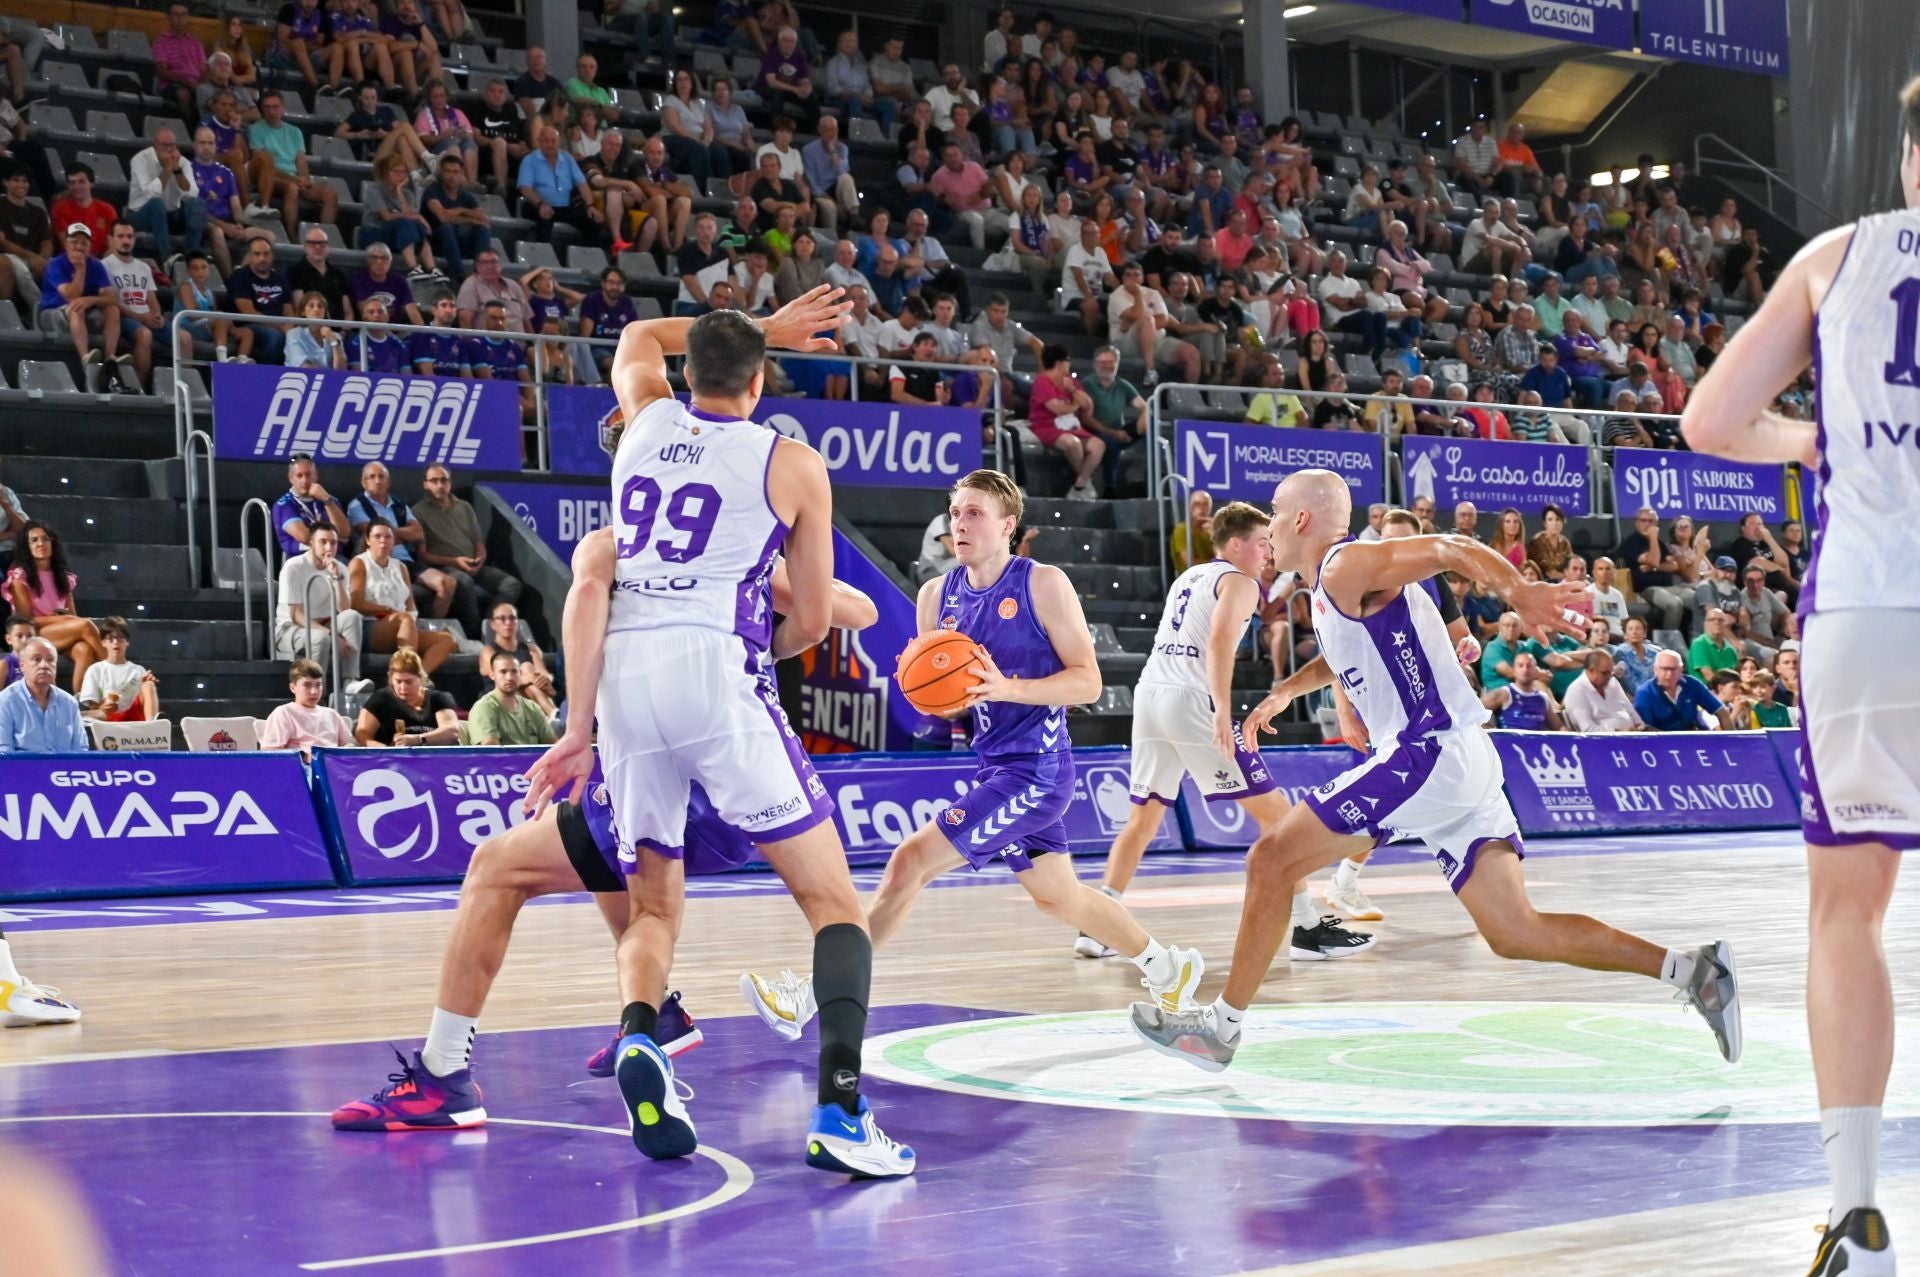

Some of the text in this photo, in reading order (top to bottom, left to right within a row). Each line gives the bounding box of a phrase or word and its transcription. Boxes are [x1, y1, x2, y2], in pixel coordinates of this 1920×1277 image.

[1532, 5, 1590, 28] OCASIÓN
[1651, 33, 1780, 69] TALENTTIUM
[113, 274, 148, 290] OSLO
[253, 371, 484, 465] ALCOPAL
[820, 410, 962, 475] ovlac
[1864, 421, 1920, 449] IV
[1234, 445, 1373, 470] MORALESCERVERA
[1446, 446, 1585, 488] La casa dulce
[1692, 469, 1755, 490] SABORES
[1527, 494, 1571, 505] CATERING
[1694, 492, 1777, 514] PALENTINOS
[617, 474, 723, 564] 99
[1171, 588, 1192, 632] 3
[1611, 750, 1738, 768] HOTEL
[50, 770, 157, 787] GRUPO
[445, 768, 534, 799] súpe
[1610, 785, 1668, 812] REY
[1669, 783, 1774, 810] SANCHO
[1340, 799, 1368, 825] CBC
